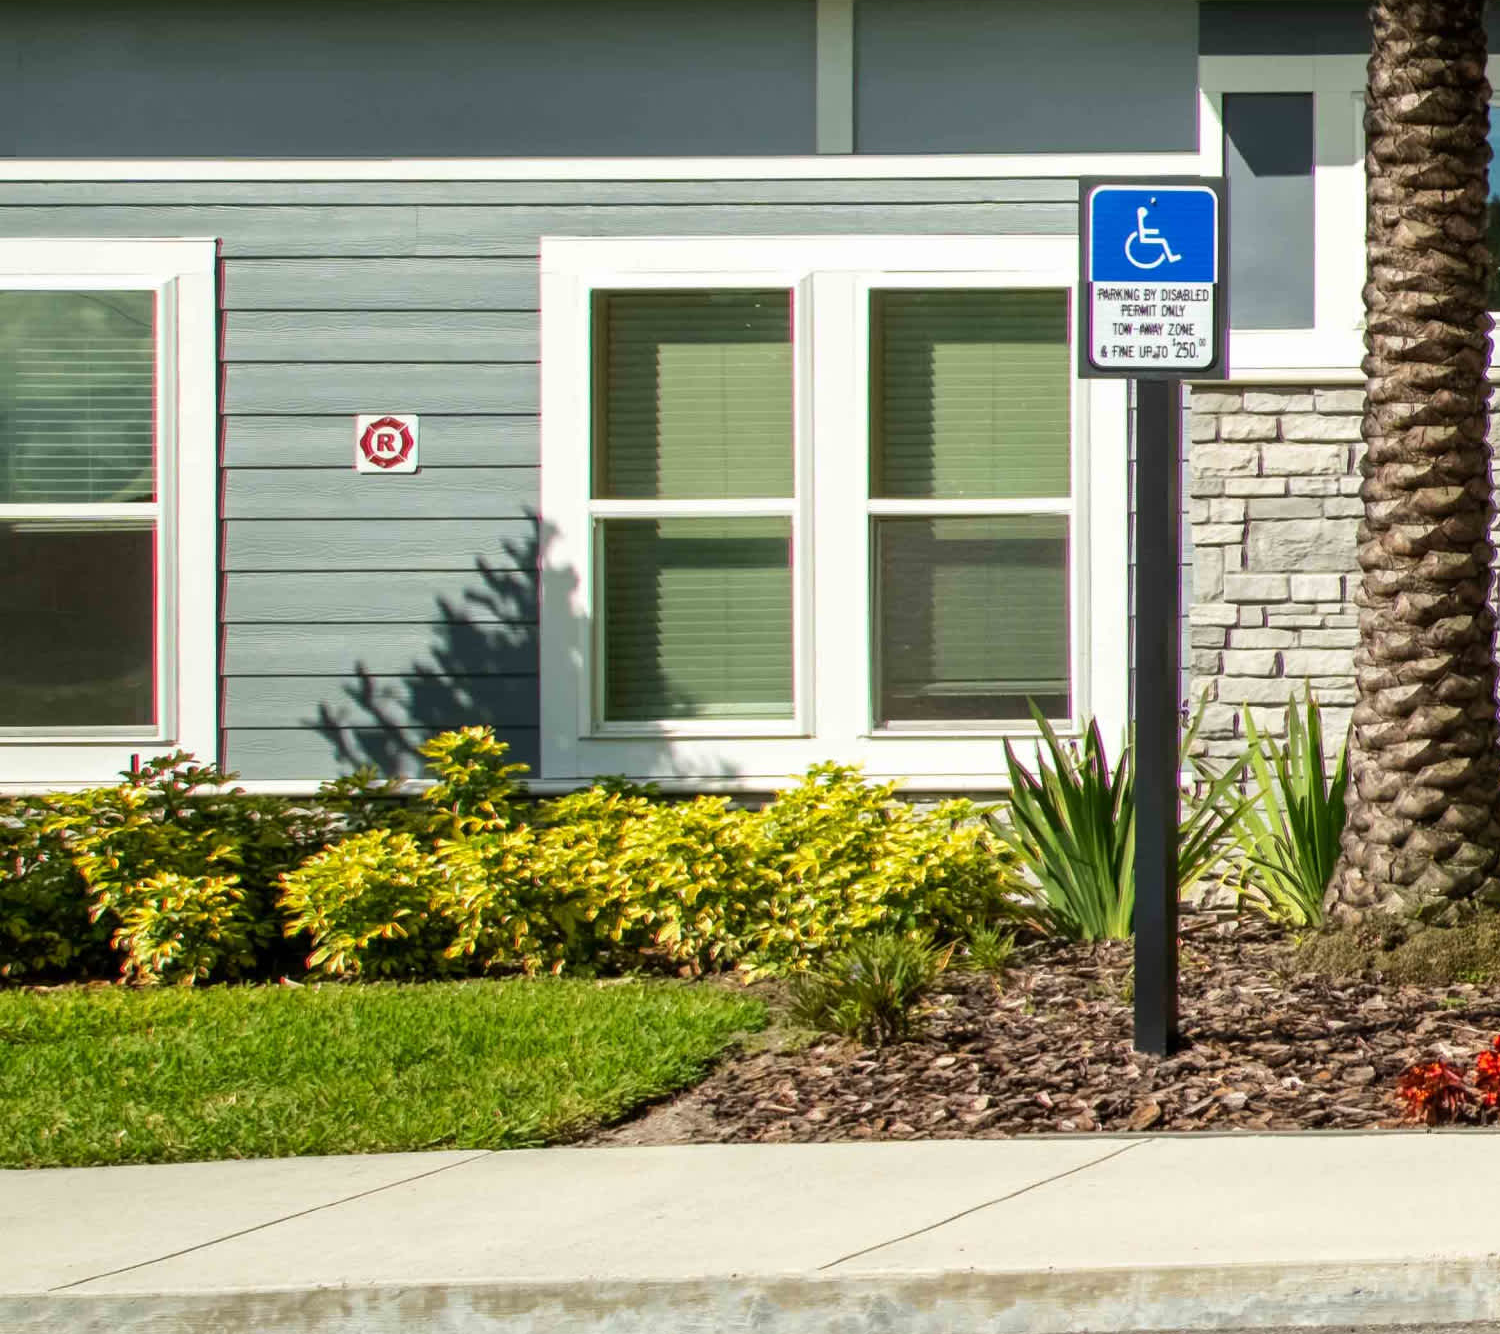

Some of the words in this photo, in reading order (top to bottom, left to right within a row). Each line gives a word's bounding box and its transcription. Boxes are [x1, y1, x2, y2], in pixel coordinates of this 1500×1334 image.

[1097, 288, 1140, 301] PARKING
[1144, 289, 1156, 301] BY
[1161, 289, 1209, 301] DISABLED
[1121, 305, 1156, 316] PERMIT
[1162, 305, 1185, 316] ONLY
[1113, 323, 1164, 335] TOW-AWAY
[1168, 323, 1194, 335] ZONE
[1101, 346, 1107, 357] &
[1112, 346, 1134, 357] FINE
[377, 433, 395, 451] R
